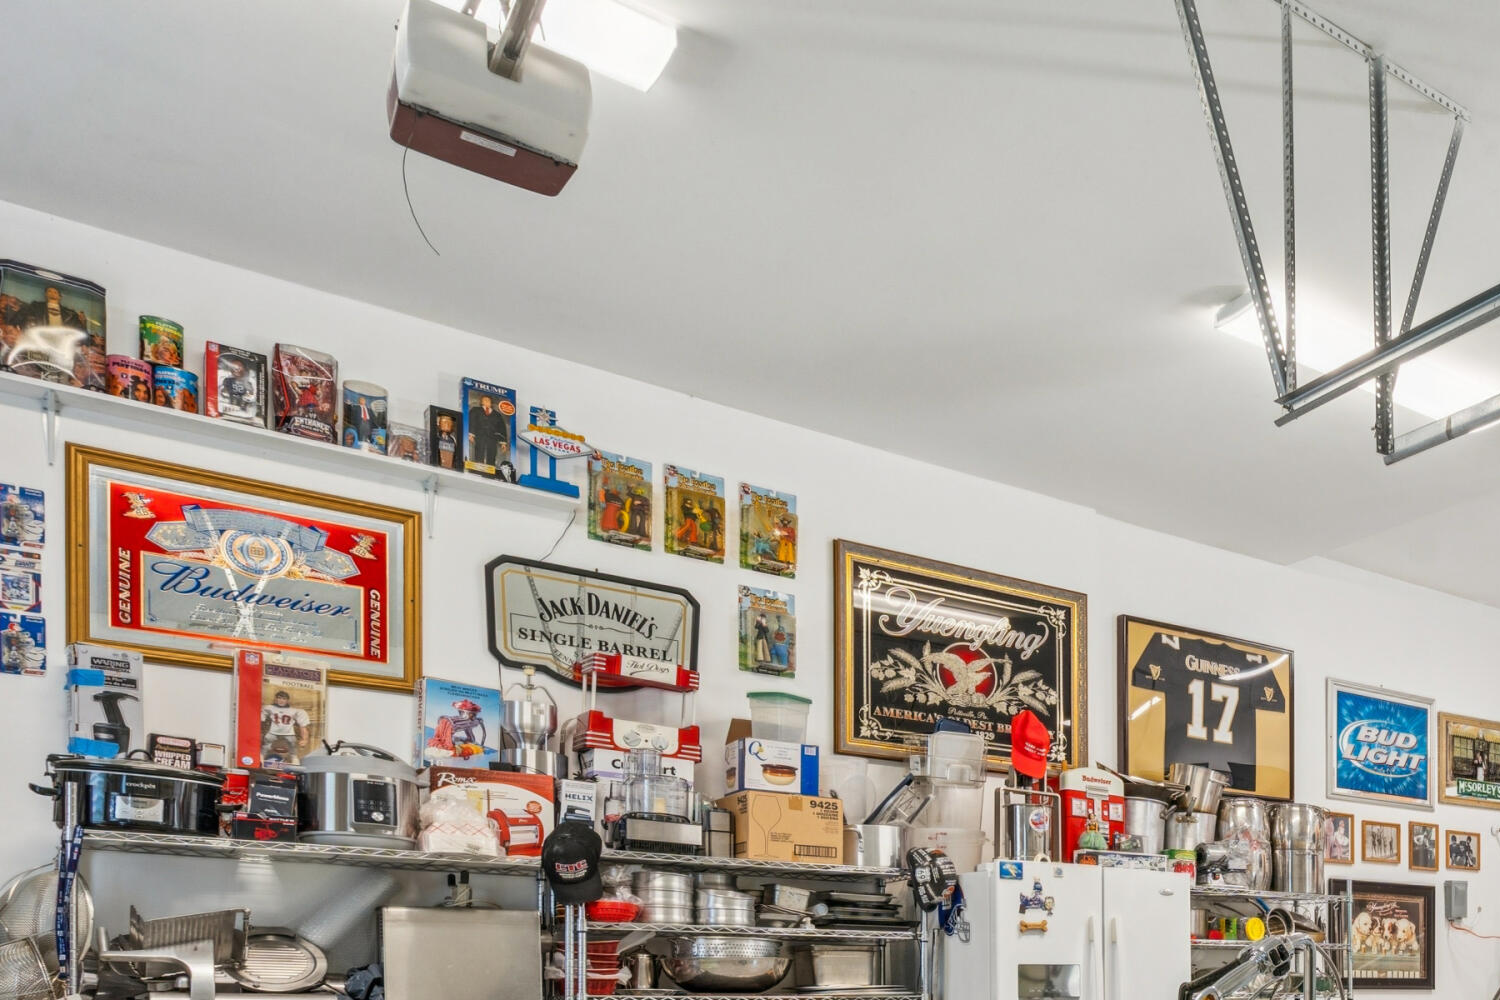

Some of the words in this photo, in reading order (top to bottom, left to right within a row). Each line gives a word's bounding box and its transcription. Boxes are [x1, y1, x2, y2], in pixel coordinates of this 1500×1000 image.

[473, 381, 508, 396] TRUMP
[534, 436, 551, 447] LAS
[552, 440, 582, 453] VEGAS
[118, 547, 131, 624] GENUINE
[151, 561, 351, 618] Budweiser
[368, 589, 382, 659] GENUINE
[537, 595, 585, 624] JACK
[586, 591, 659, 641] DANIEL'S
[879, 586, 1049, 660] Yuengling
[518, 626, 592, 650] SINGLE
[597, 639, 673, 663] BARREL
[1184, 654, 1241, 677] GUINNESS
[873, 706, 945, 724] AMERICA'S
[1186, 678, 1241, 745] 17
[1356, 725, 1418, 750] BUD
[154, 750, 191, 761] WHIPPED
[154, 758, 191, 770] CREAM
[1341, 743, 1426, 771] LIGHT
[565, 793, 593, 802] HELIX
[809, 800, 838, 811] 9425
